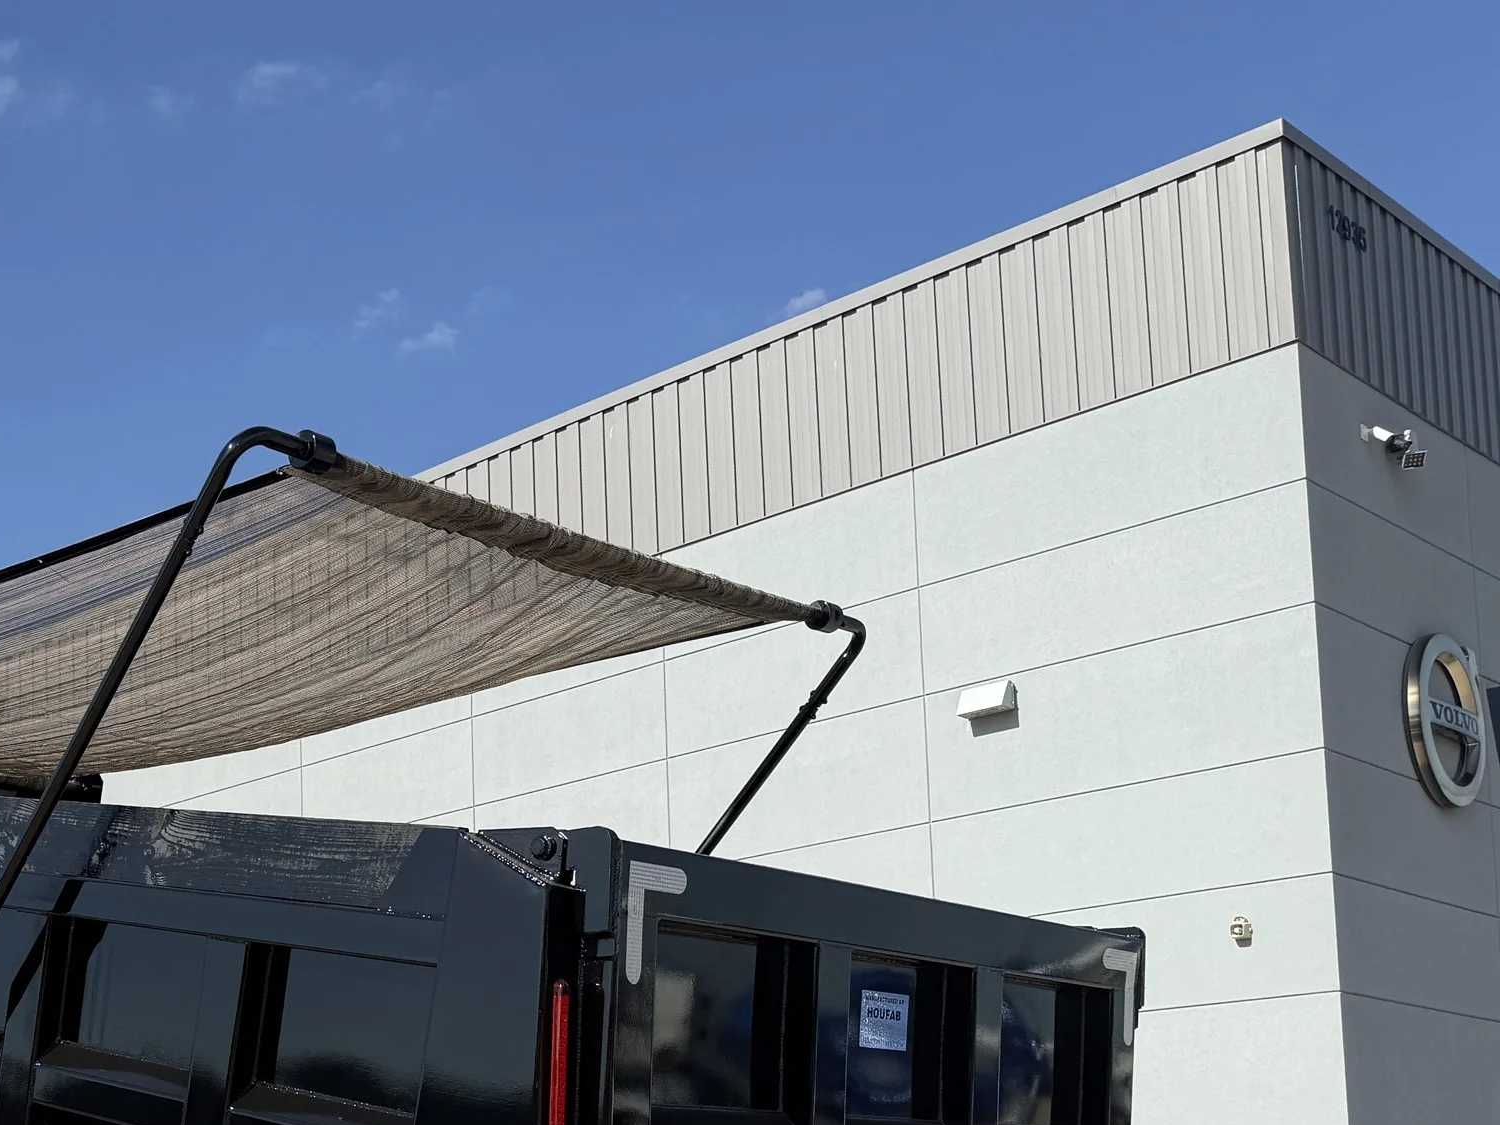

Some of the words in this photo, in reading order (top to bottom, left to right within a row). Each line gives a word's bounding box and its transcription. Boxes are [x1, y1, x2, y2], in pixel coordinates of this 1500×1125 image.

[1328, 204, 1367, 252] 12935
[1429, 700, 1479, 736] VOLVO
[867, 1007, 902, 1021] HOUFAB
